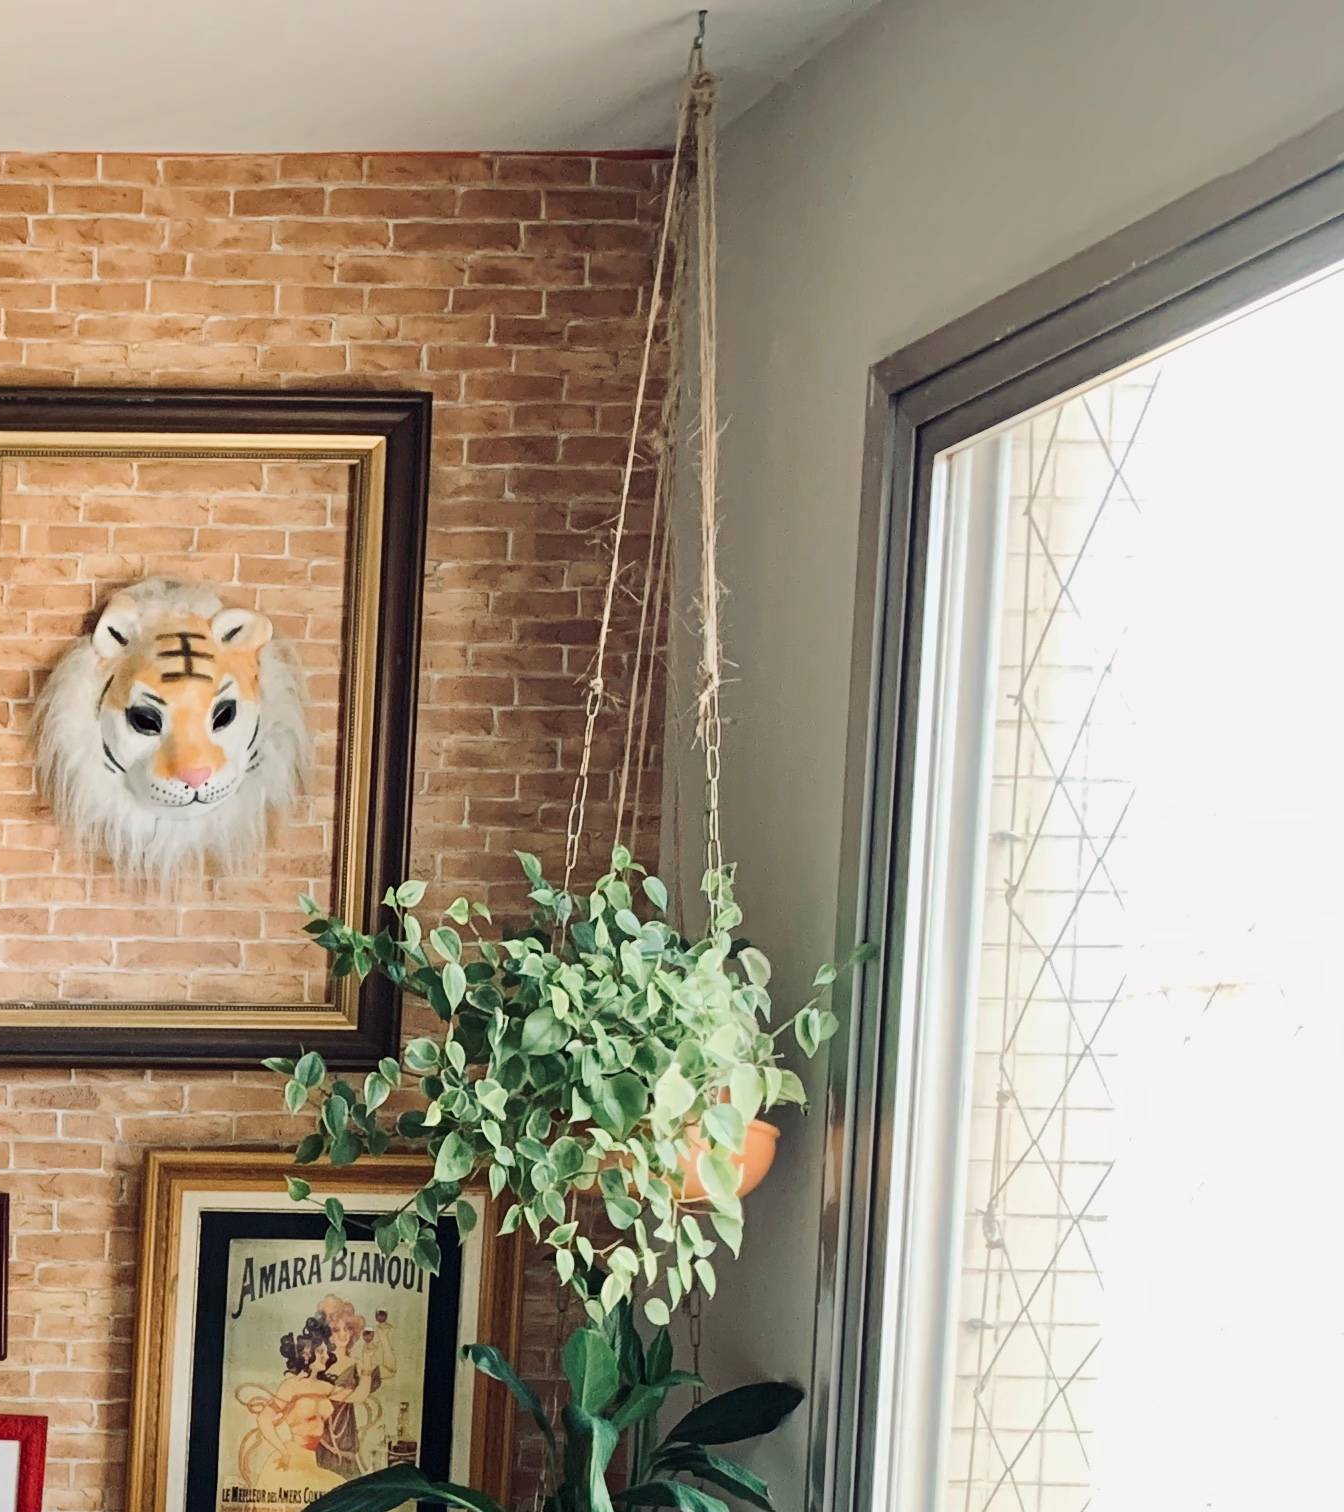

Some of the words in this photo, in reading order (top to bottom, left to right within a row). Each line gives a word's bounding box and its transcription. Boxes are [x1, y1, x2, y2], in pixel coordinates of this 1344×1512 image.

[231, 1254, 322, 1320] AMARA
[329, 1246, 424, 1293] BLANQUI
[222, 1488, 230, 1502] LE
